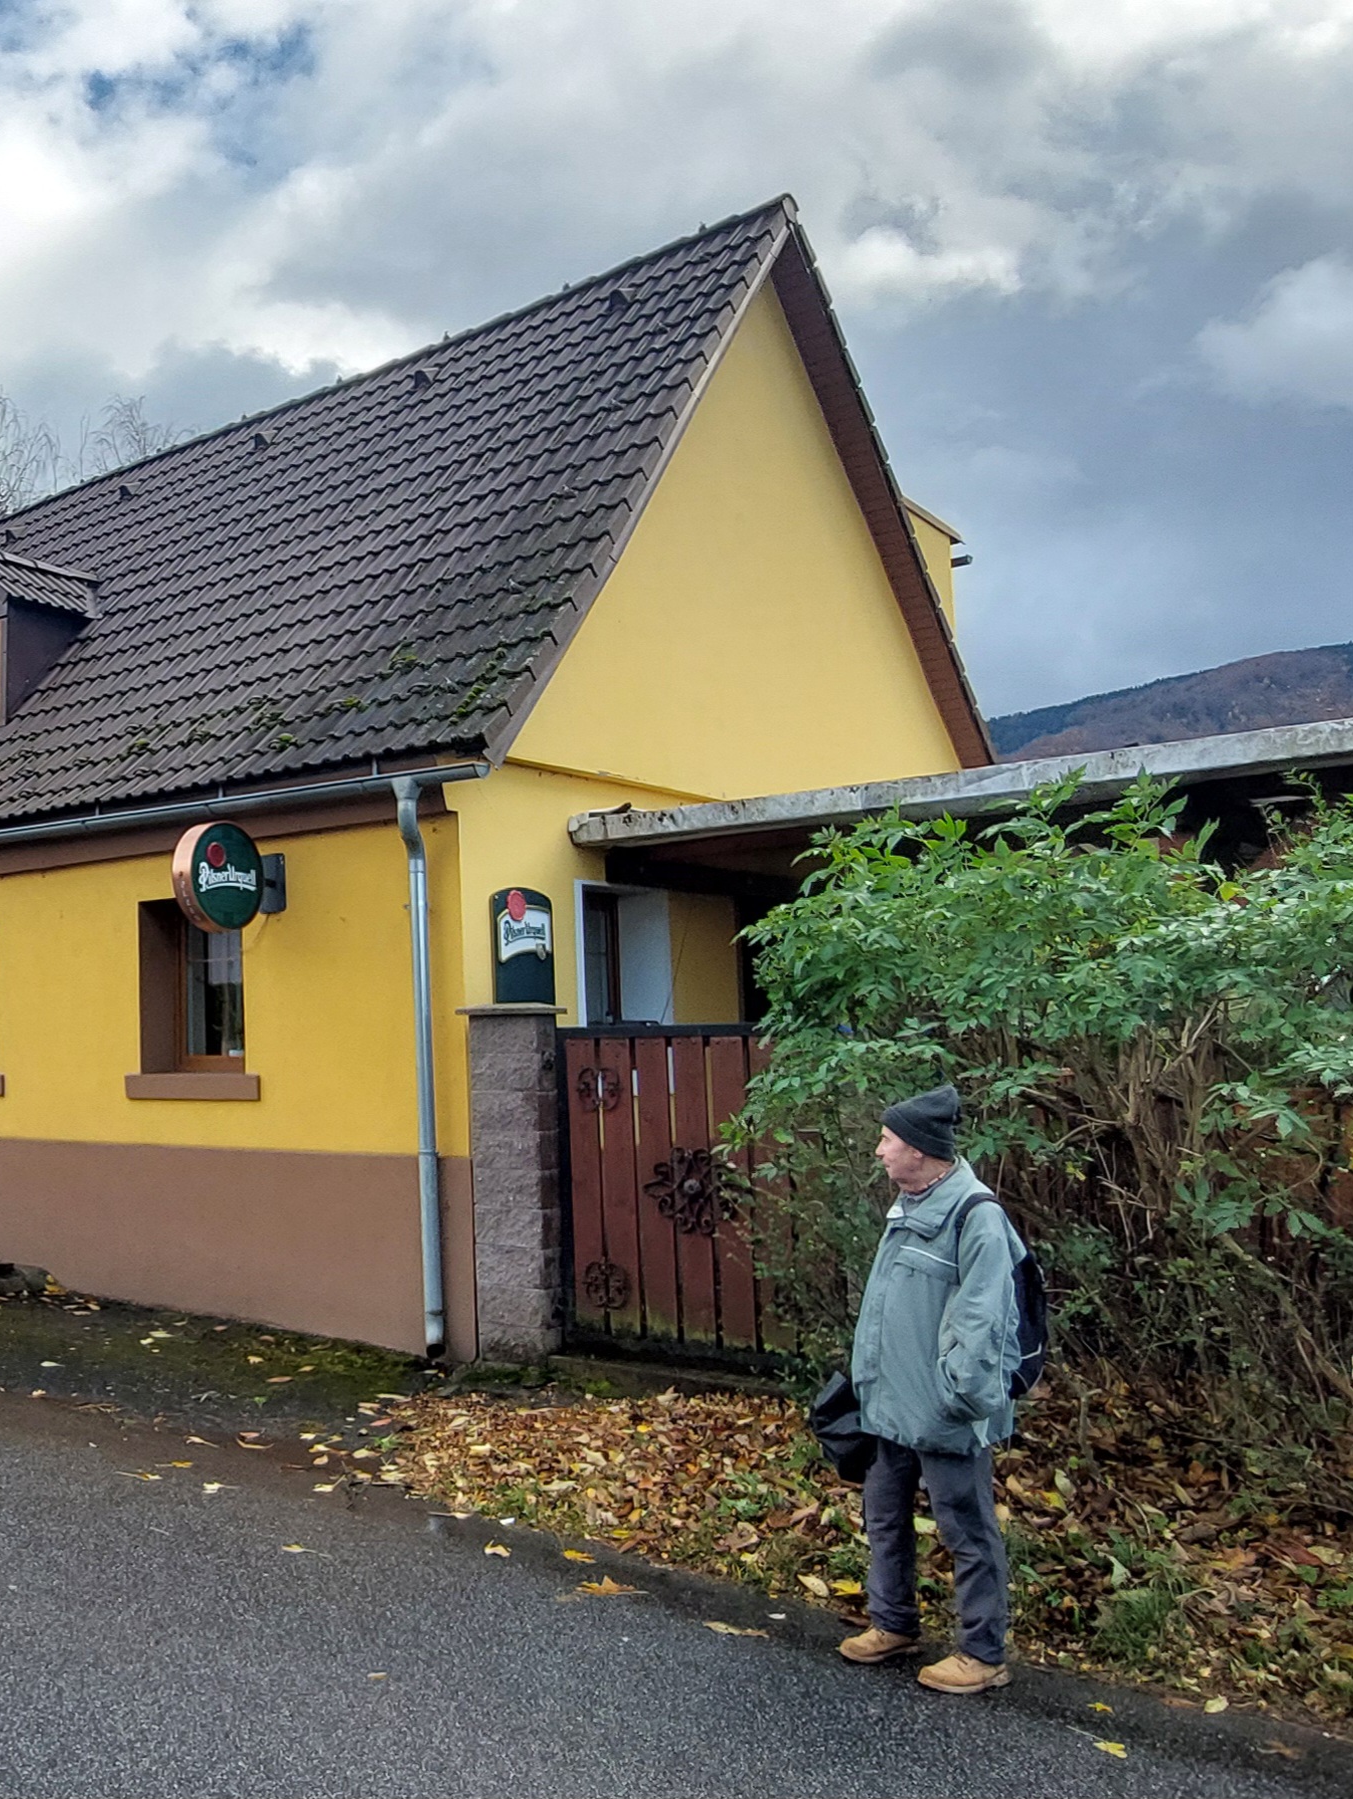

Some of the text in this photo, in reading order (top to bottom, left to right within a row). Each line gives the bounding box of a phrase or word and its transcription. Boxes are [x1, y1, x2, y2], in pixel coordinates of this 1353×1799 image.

[198, 862, 256, 893] Pilsner Urquell
[503, 920, 525, 947] Pilsner
